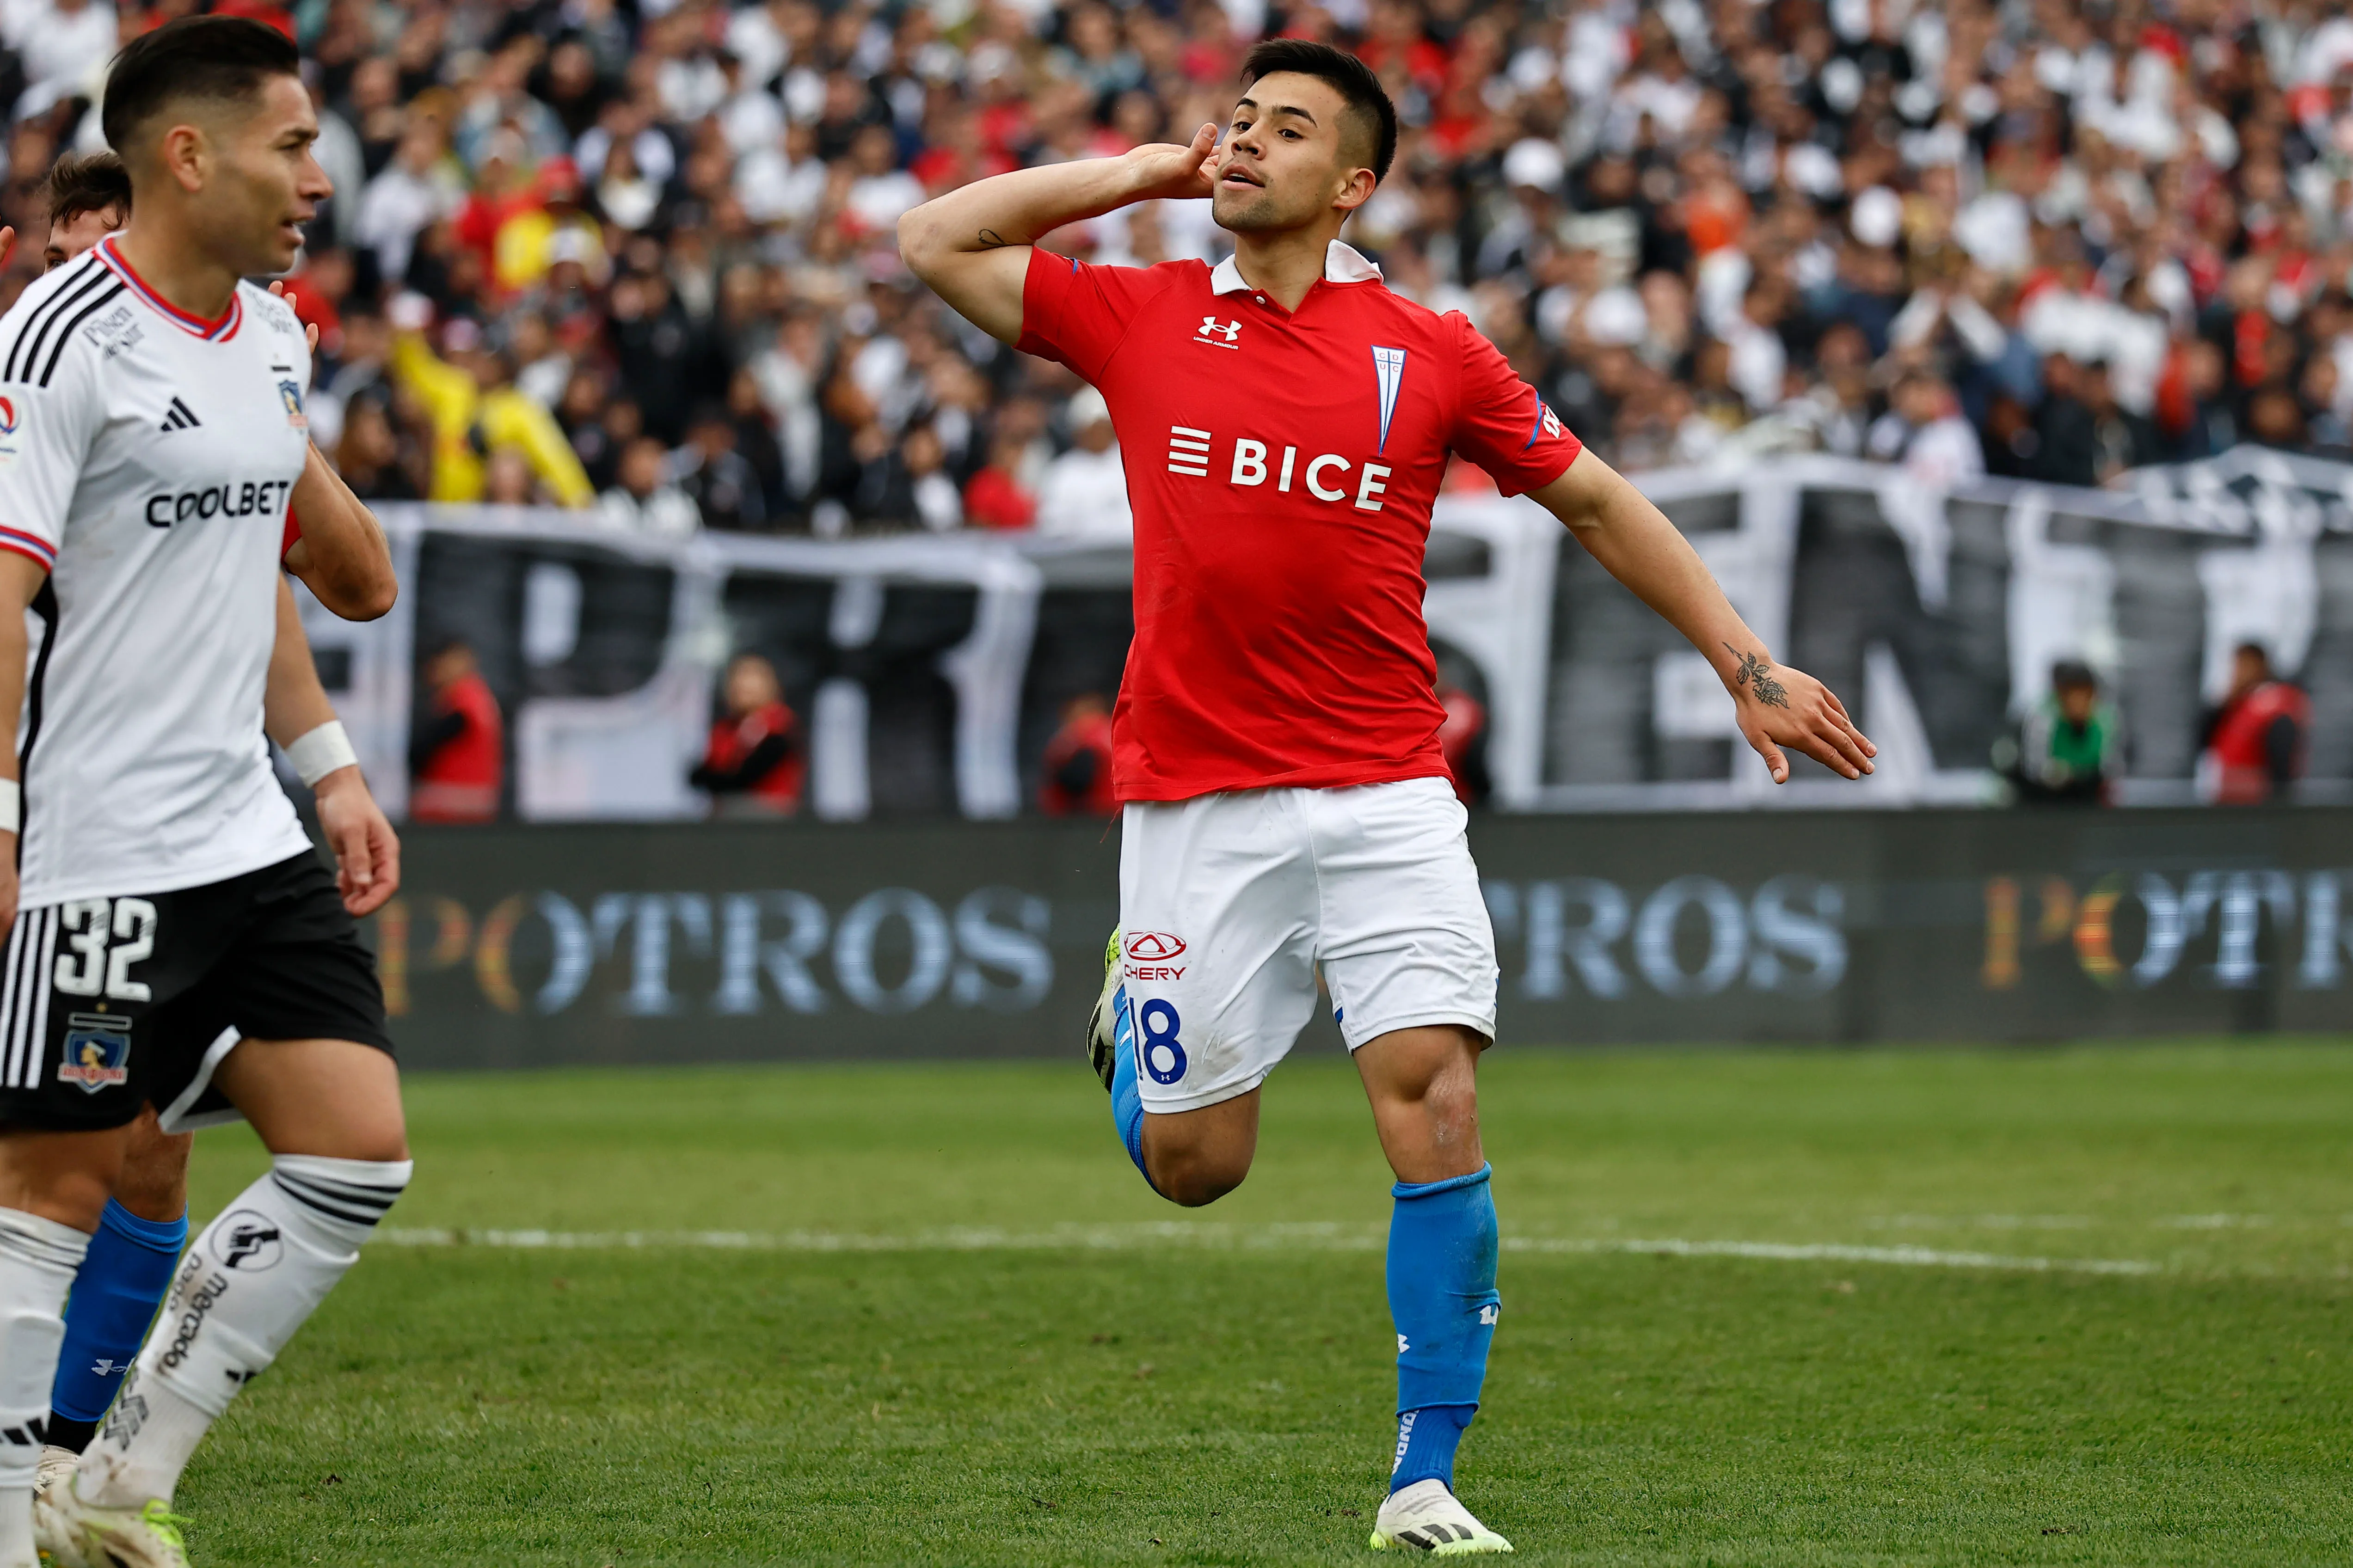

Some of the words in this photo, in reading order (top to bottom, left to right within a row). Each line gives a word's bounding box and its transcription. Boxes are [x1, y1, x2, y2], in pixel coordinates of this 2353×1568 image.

[1193, 336, 1213, 344] UNDER
[1212, 341, 1239, 350] ARMOUR
[146, 481, 289, 528] COOLBET
[1230, 437, 1393, 511] BICE
[52, 896, 158, 1003] 32
[374, 884, 1058, 1017] POTROS
[1124, 963, 1187, 980] CHERY
[1482, 871, 1849, 1002] ROS
[1129, 997, 1187, 1085] 18
[163, 1272, 228, 1367] mercado
